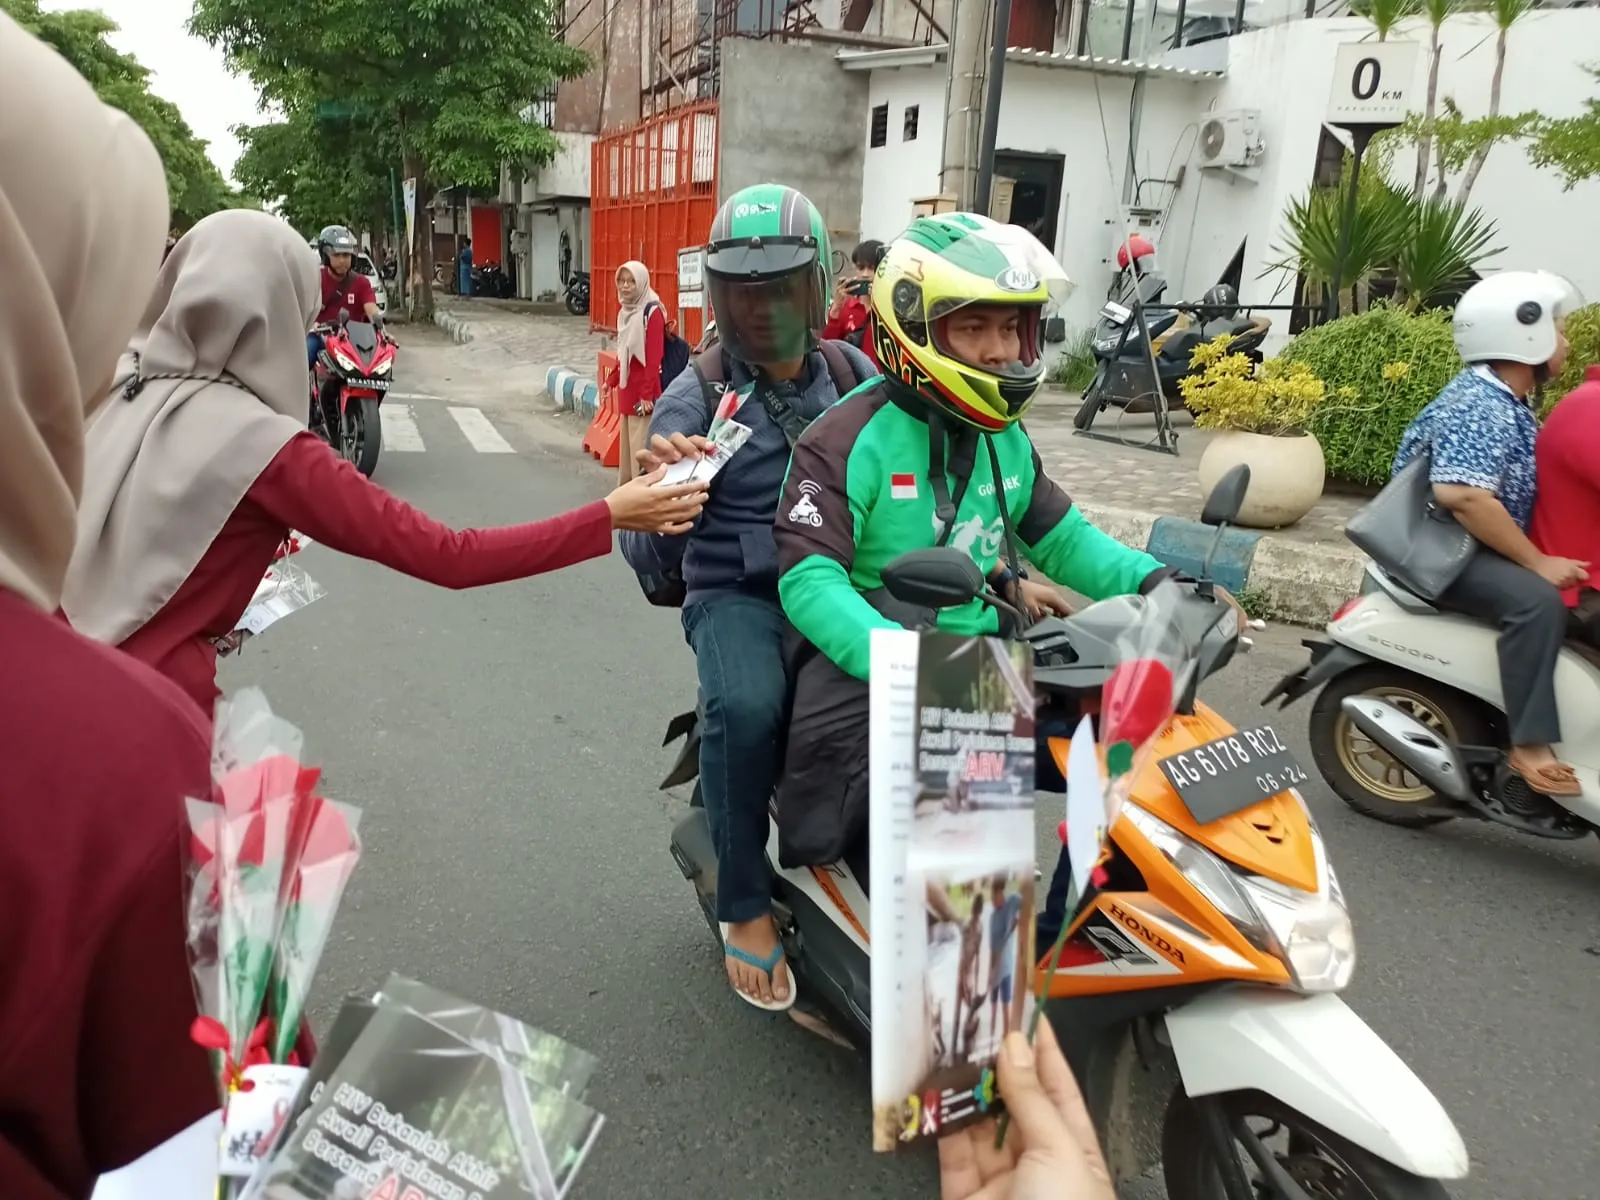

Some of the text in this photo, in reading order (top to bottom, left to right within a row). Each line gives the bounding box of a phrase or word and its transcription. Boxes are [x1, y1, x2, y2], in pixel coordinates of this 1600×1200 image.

[1352, 57, 1402, 100] 0 KM
[963, 751, 1006, 781] ARV
[1166, 725, 1287, 789] AG 6178 RCZ
[1109, 903, 1186, 965] HONDA
[317, 1106, 374, 1149] Awali
[333, 1082, 373, 1115] HIV
[367, 1101, 450, 1164] Bukanlah
[448, 1151, 499, 1192] Akhir
[302, 1129, 381, 1187] Bersama
